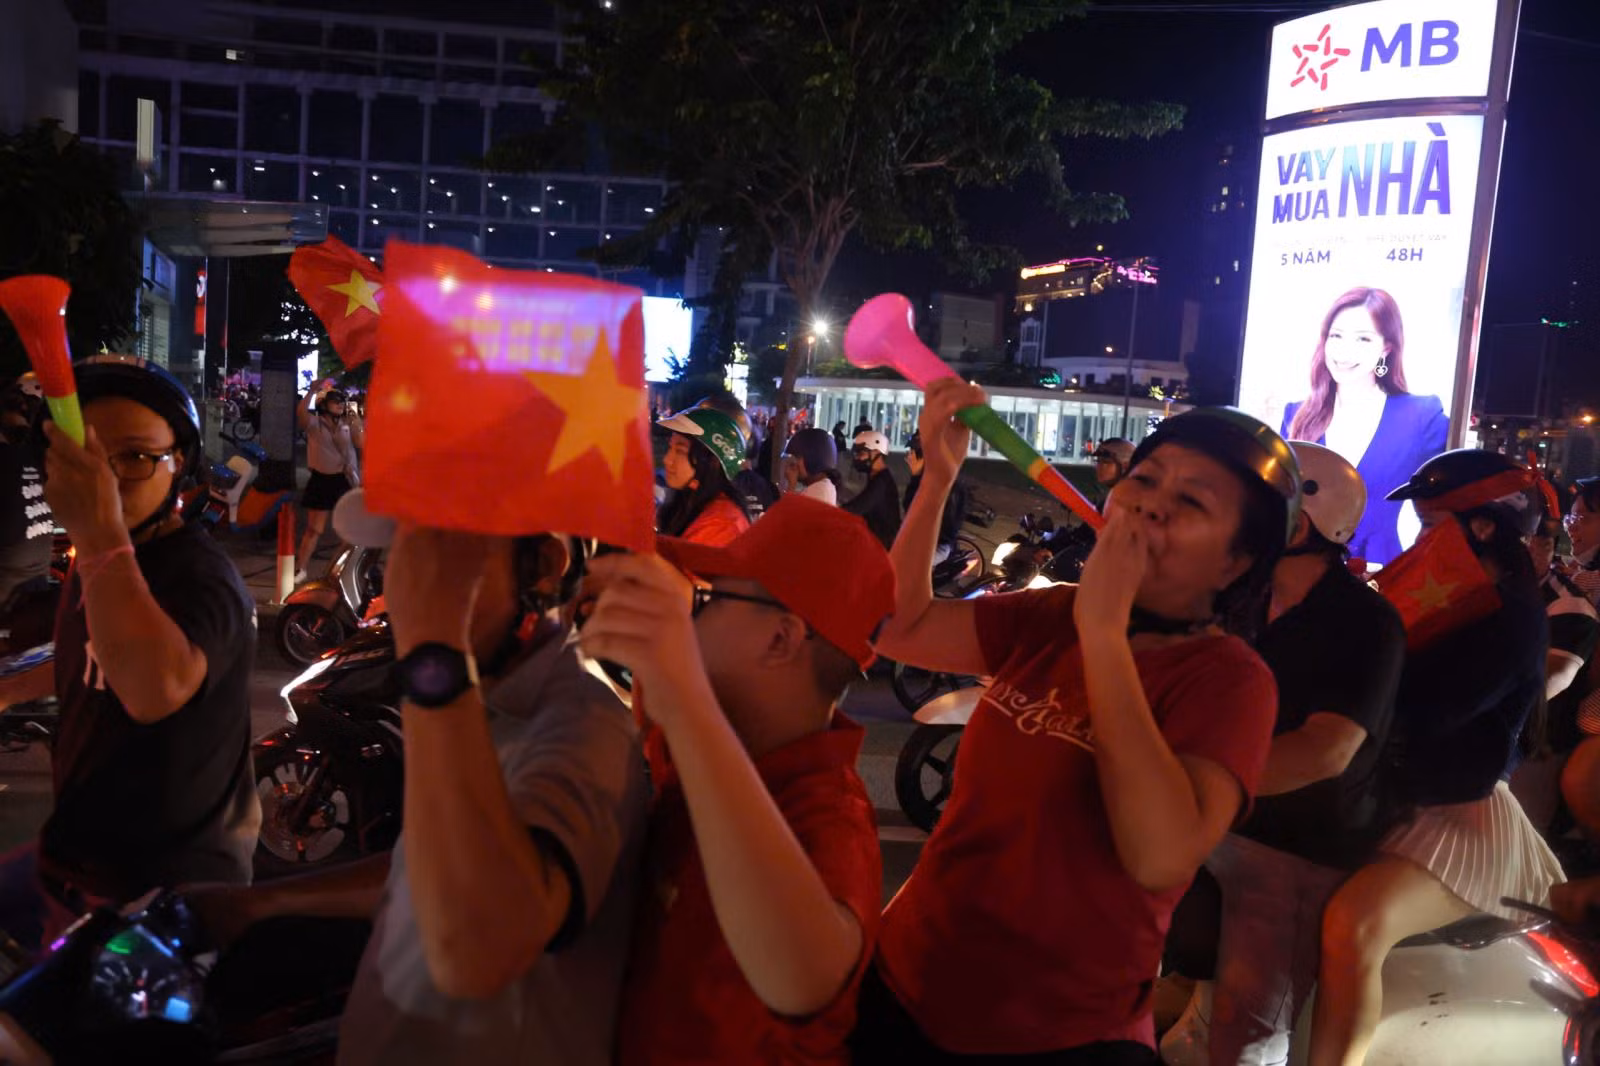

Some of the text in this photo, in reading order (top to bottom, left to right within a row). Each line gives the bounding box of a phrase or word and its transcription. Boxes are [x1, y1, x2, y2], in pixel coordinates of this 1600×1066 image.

[1360, 20, 1459, 72] MB
[1277, 147, 1336, 185] VAY
[1338, 122, 1451, 218] NHÀ
[1272, 189, 1330, 224] MUA
[1281, 248, 1330, 266] 5 NĂM
[1386, 247, 1424, 262] 48H
